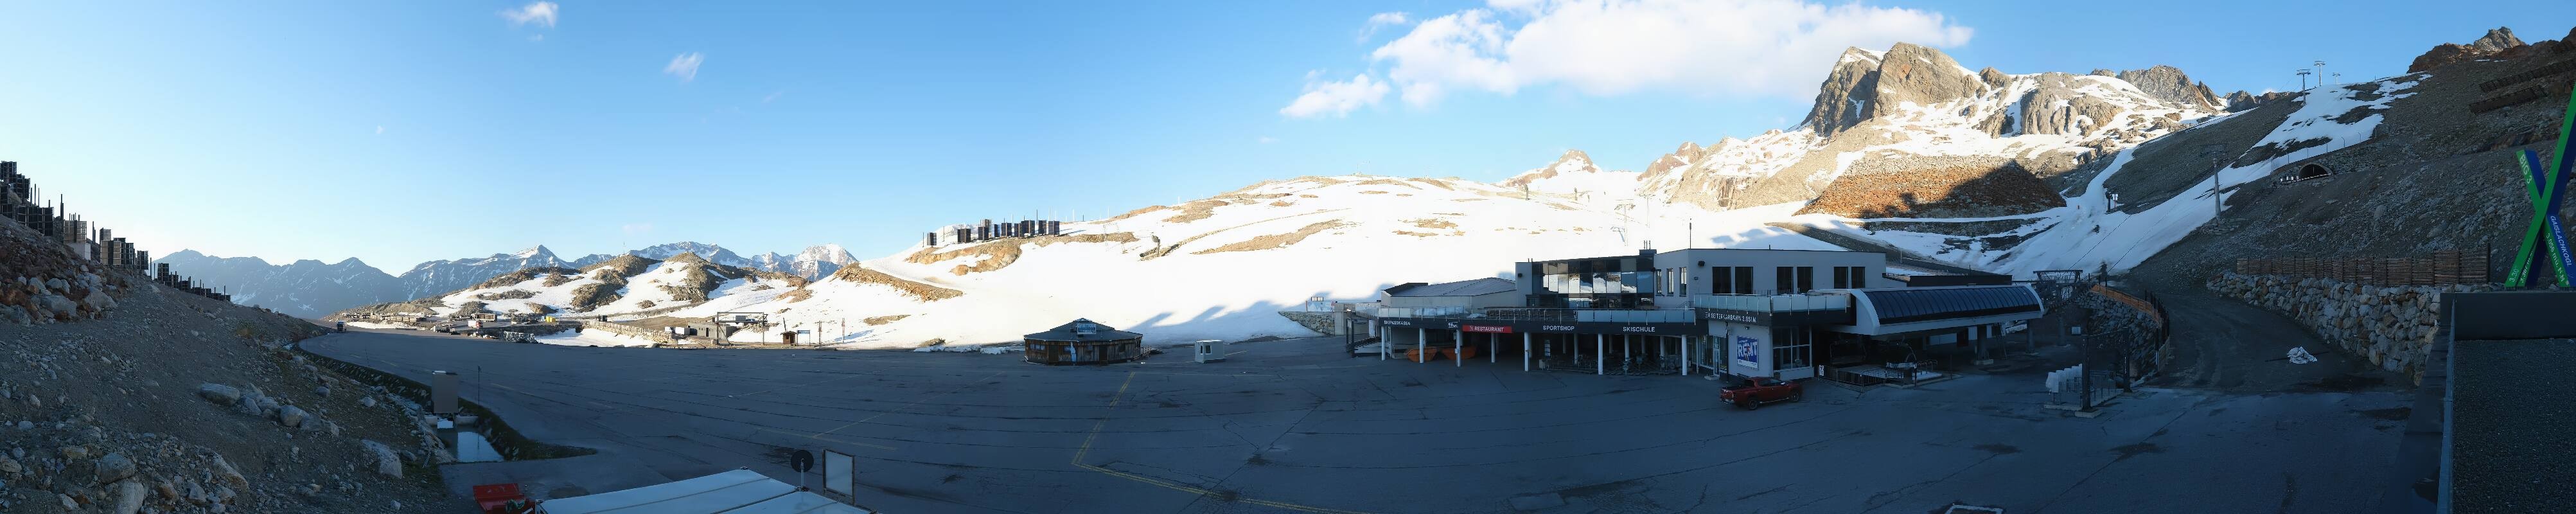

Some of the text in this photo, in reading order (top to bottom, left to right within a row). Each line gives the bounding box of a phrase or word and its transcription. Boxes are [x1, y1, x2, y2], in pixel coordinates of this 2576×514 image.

[2520, 154, 2532, 184] BIG 3
[2550, 215, 2573, 267] GAISLACHKOGL
[1737, 342, 1758, 357] RENT
